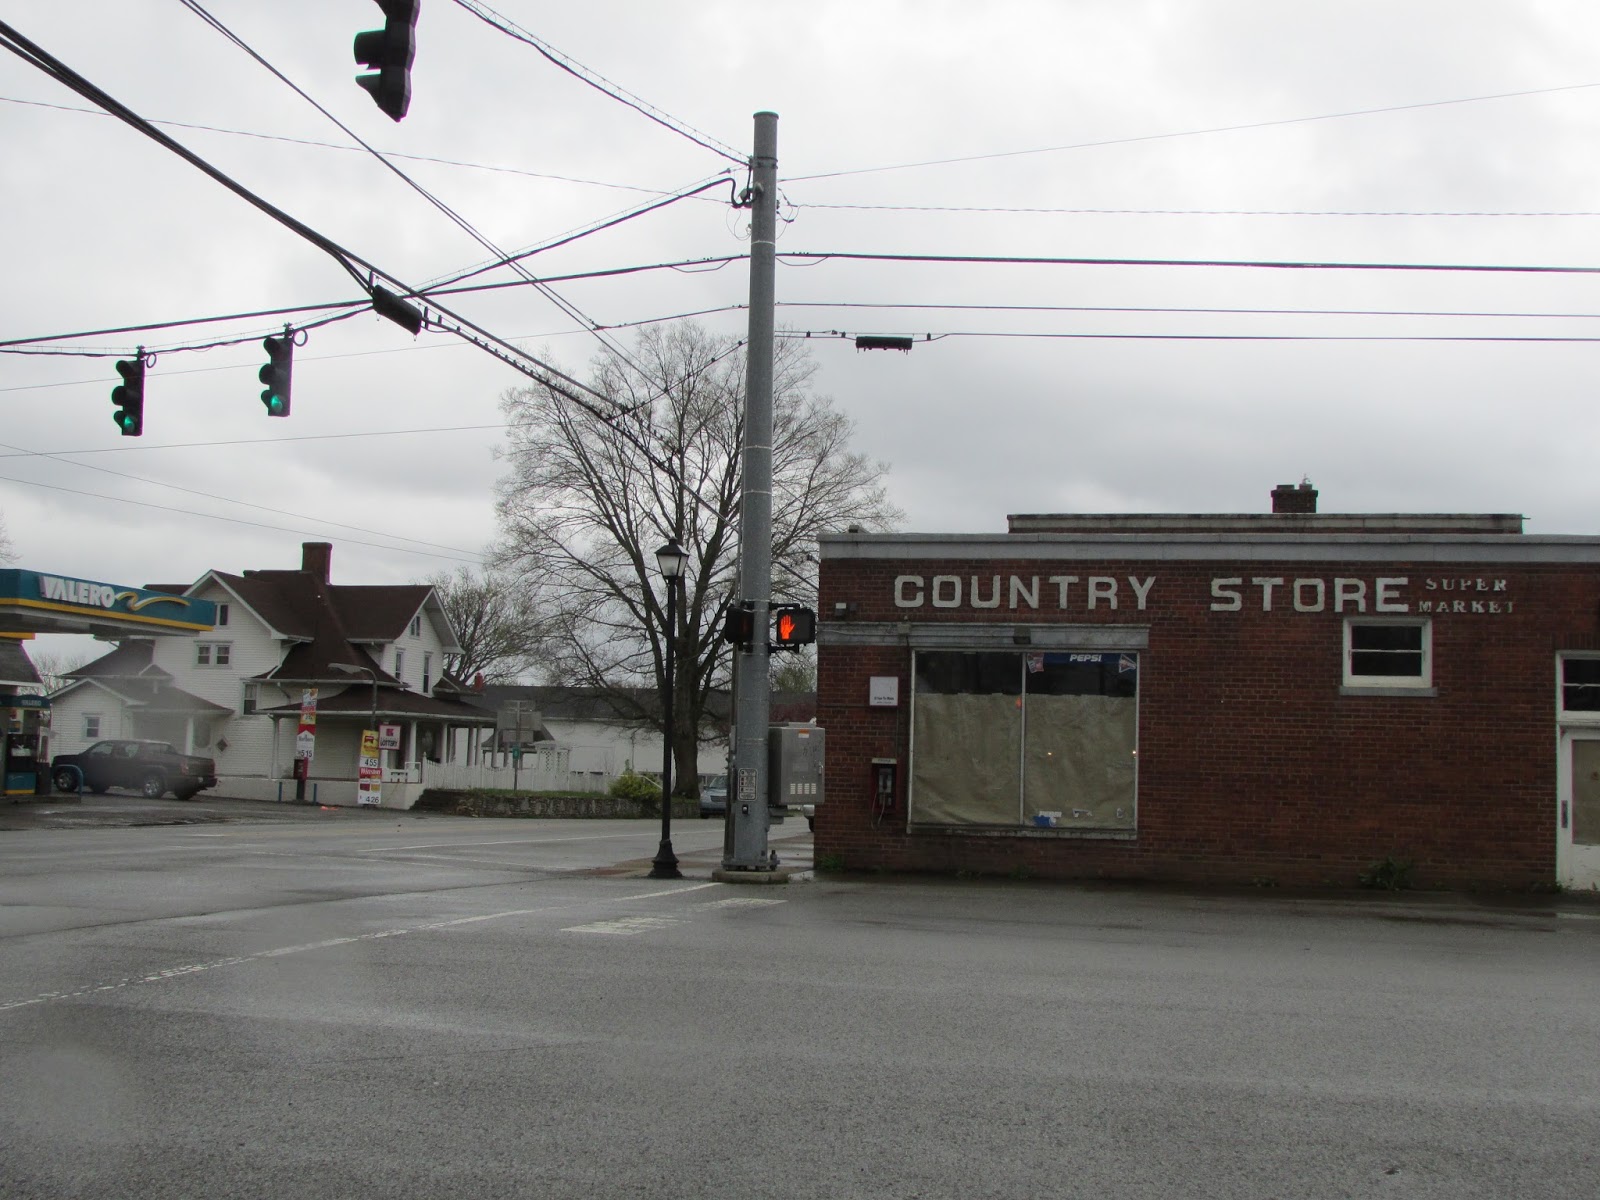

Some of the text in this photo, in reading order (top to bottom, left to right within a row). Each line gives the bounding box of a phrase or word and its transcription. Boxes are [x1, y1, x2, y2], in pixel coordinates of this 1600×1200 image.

[1425, 578, 1507, 591] SUPER
[40, 576, 115, 608] VALERO
[894, 575, 1409, 613] COUNTRY STORE
[1418, 600, 1513, 613] MARKET
[1069, 654, 1102, 662] PEPSI
